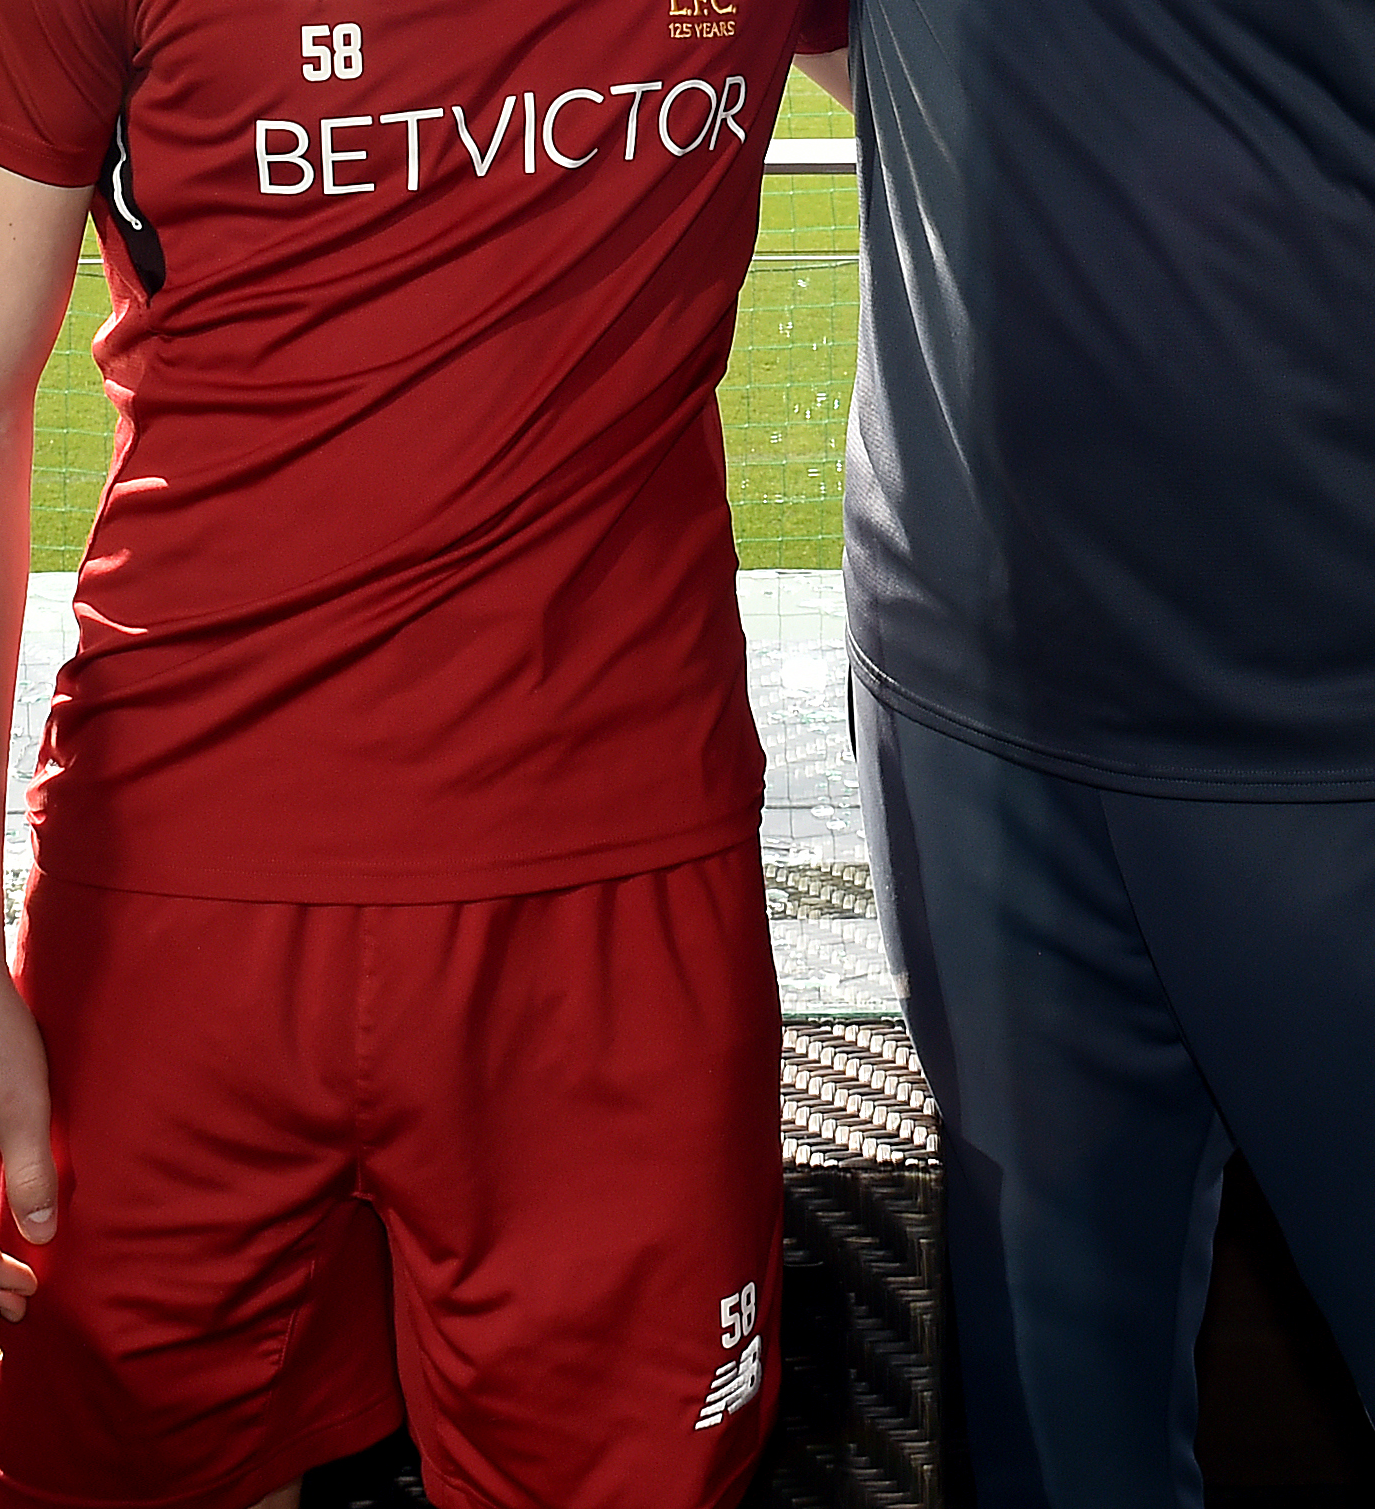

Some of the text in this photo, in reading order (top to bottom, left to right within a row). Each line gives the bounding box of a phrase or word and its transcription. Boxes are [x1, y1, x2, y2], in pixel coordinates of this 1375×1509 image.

[301, 22, 364, 82] 58
[668, 21, 736, 39] 125 YEARS
[255, 74, 747, 195] BETVICTOR
[720, 1281, 756, 1349] 58
